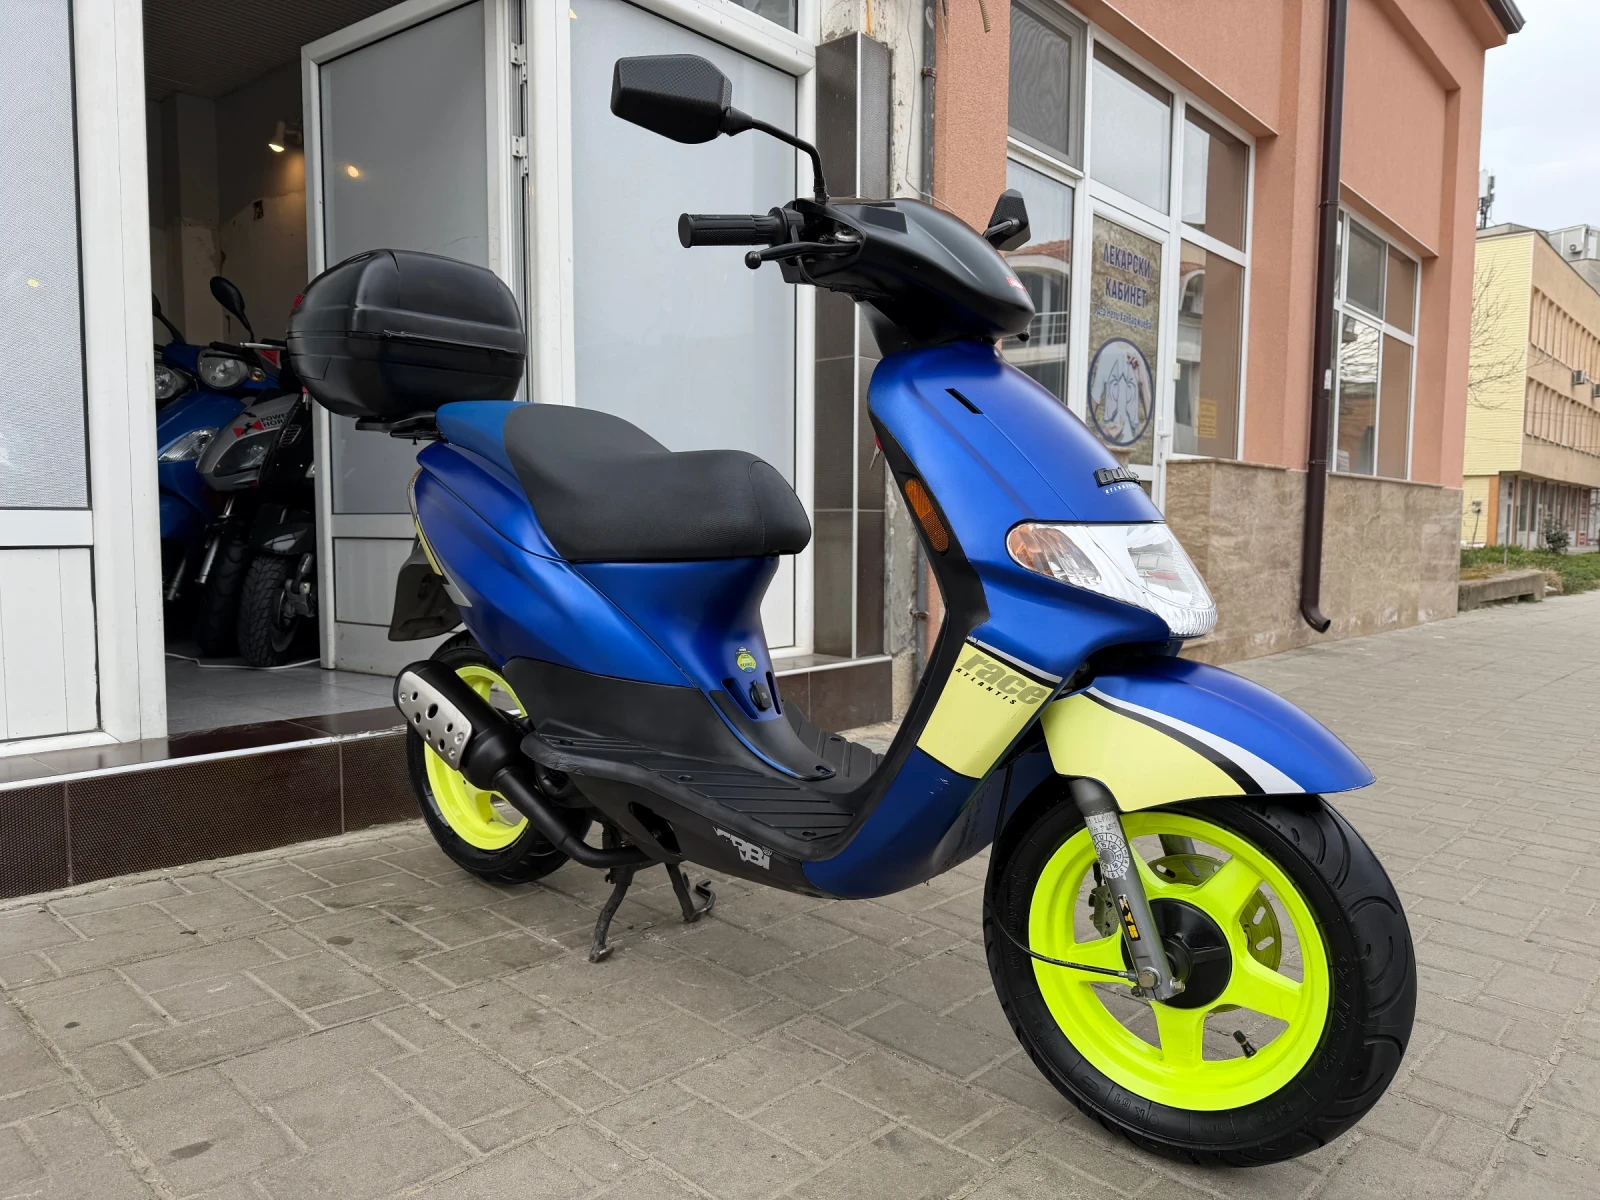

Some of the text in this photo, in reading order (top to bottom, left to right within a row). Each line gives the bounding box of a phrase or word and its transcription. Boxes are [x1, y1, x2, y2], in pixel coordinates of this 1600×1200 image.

[1103, 243, 1151, 278] ЛЕКАРСКИ
[1105, 277, 1147, 308] КАБИНЕТ
[955, 667, 1017, 704] ATLANTIS
[961, 654, 1048, 704] race
